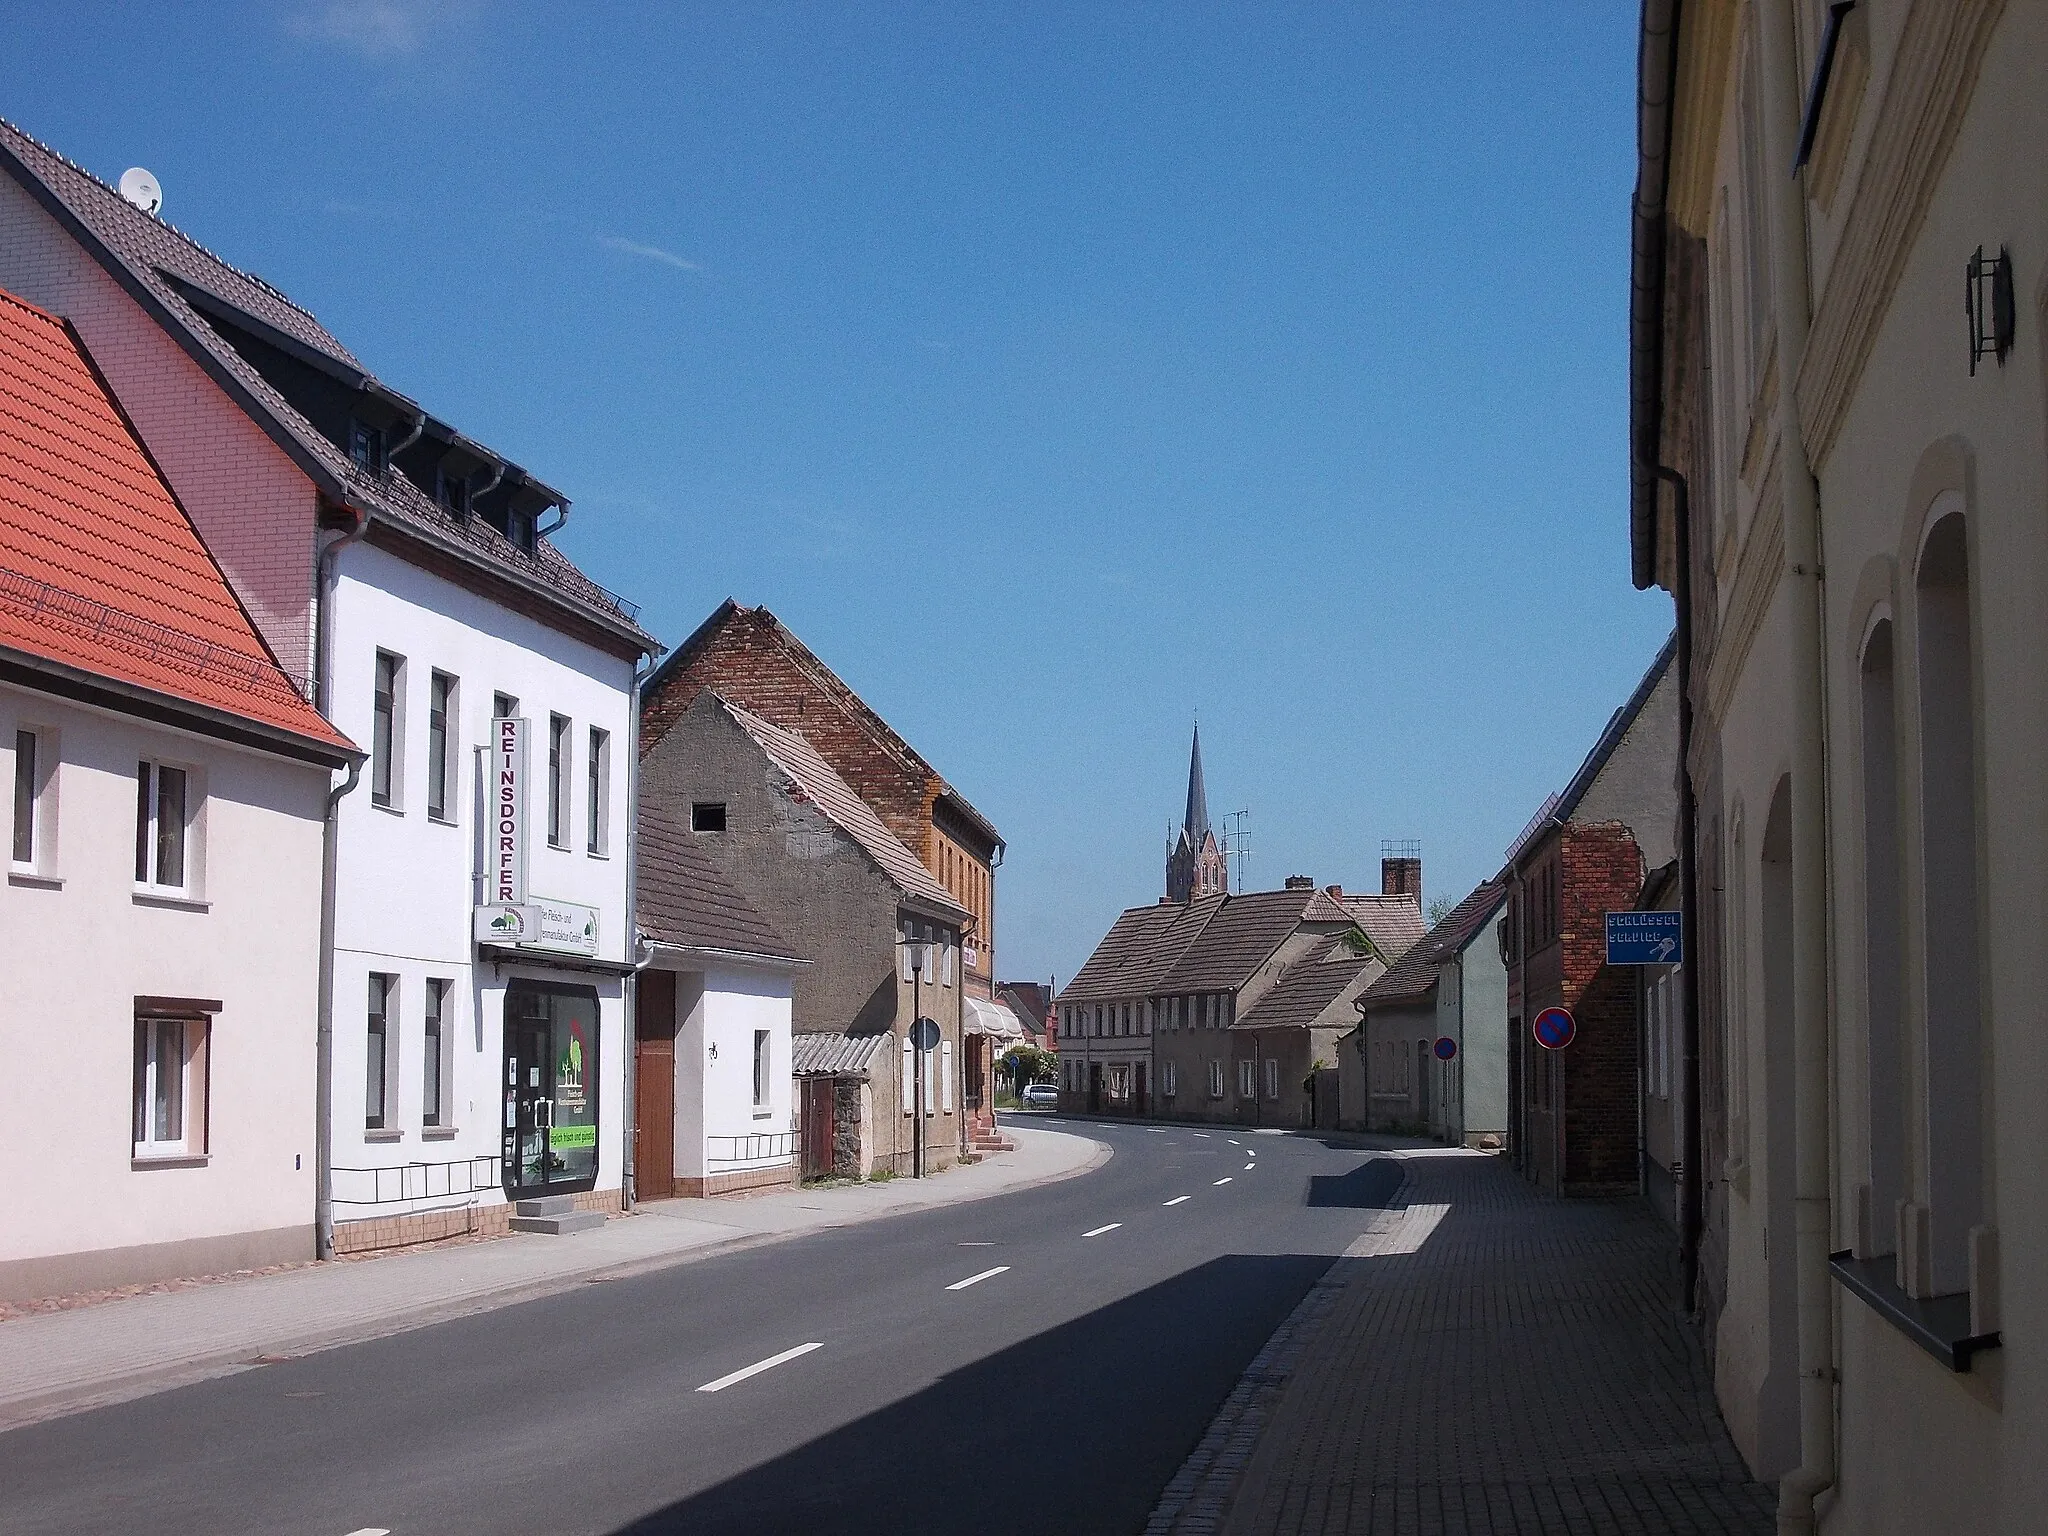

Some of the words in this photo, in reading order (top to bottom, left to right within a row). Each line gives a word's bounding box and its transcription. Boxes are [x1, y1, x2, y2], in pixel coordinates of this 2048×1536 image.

[499, 721, 516, 901] REINSDORFER
[1609, 915, 1679, 926] SCHLÜSSEL
[541, 929, 569, 942] enmanufaktur
[1609, 931, 1661, 943] SERVICE
